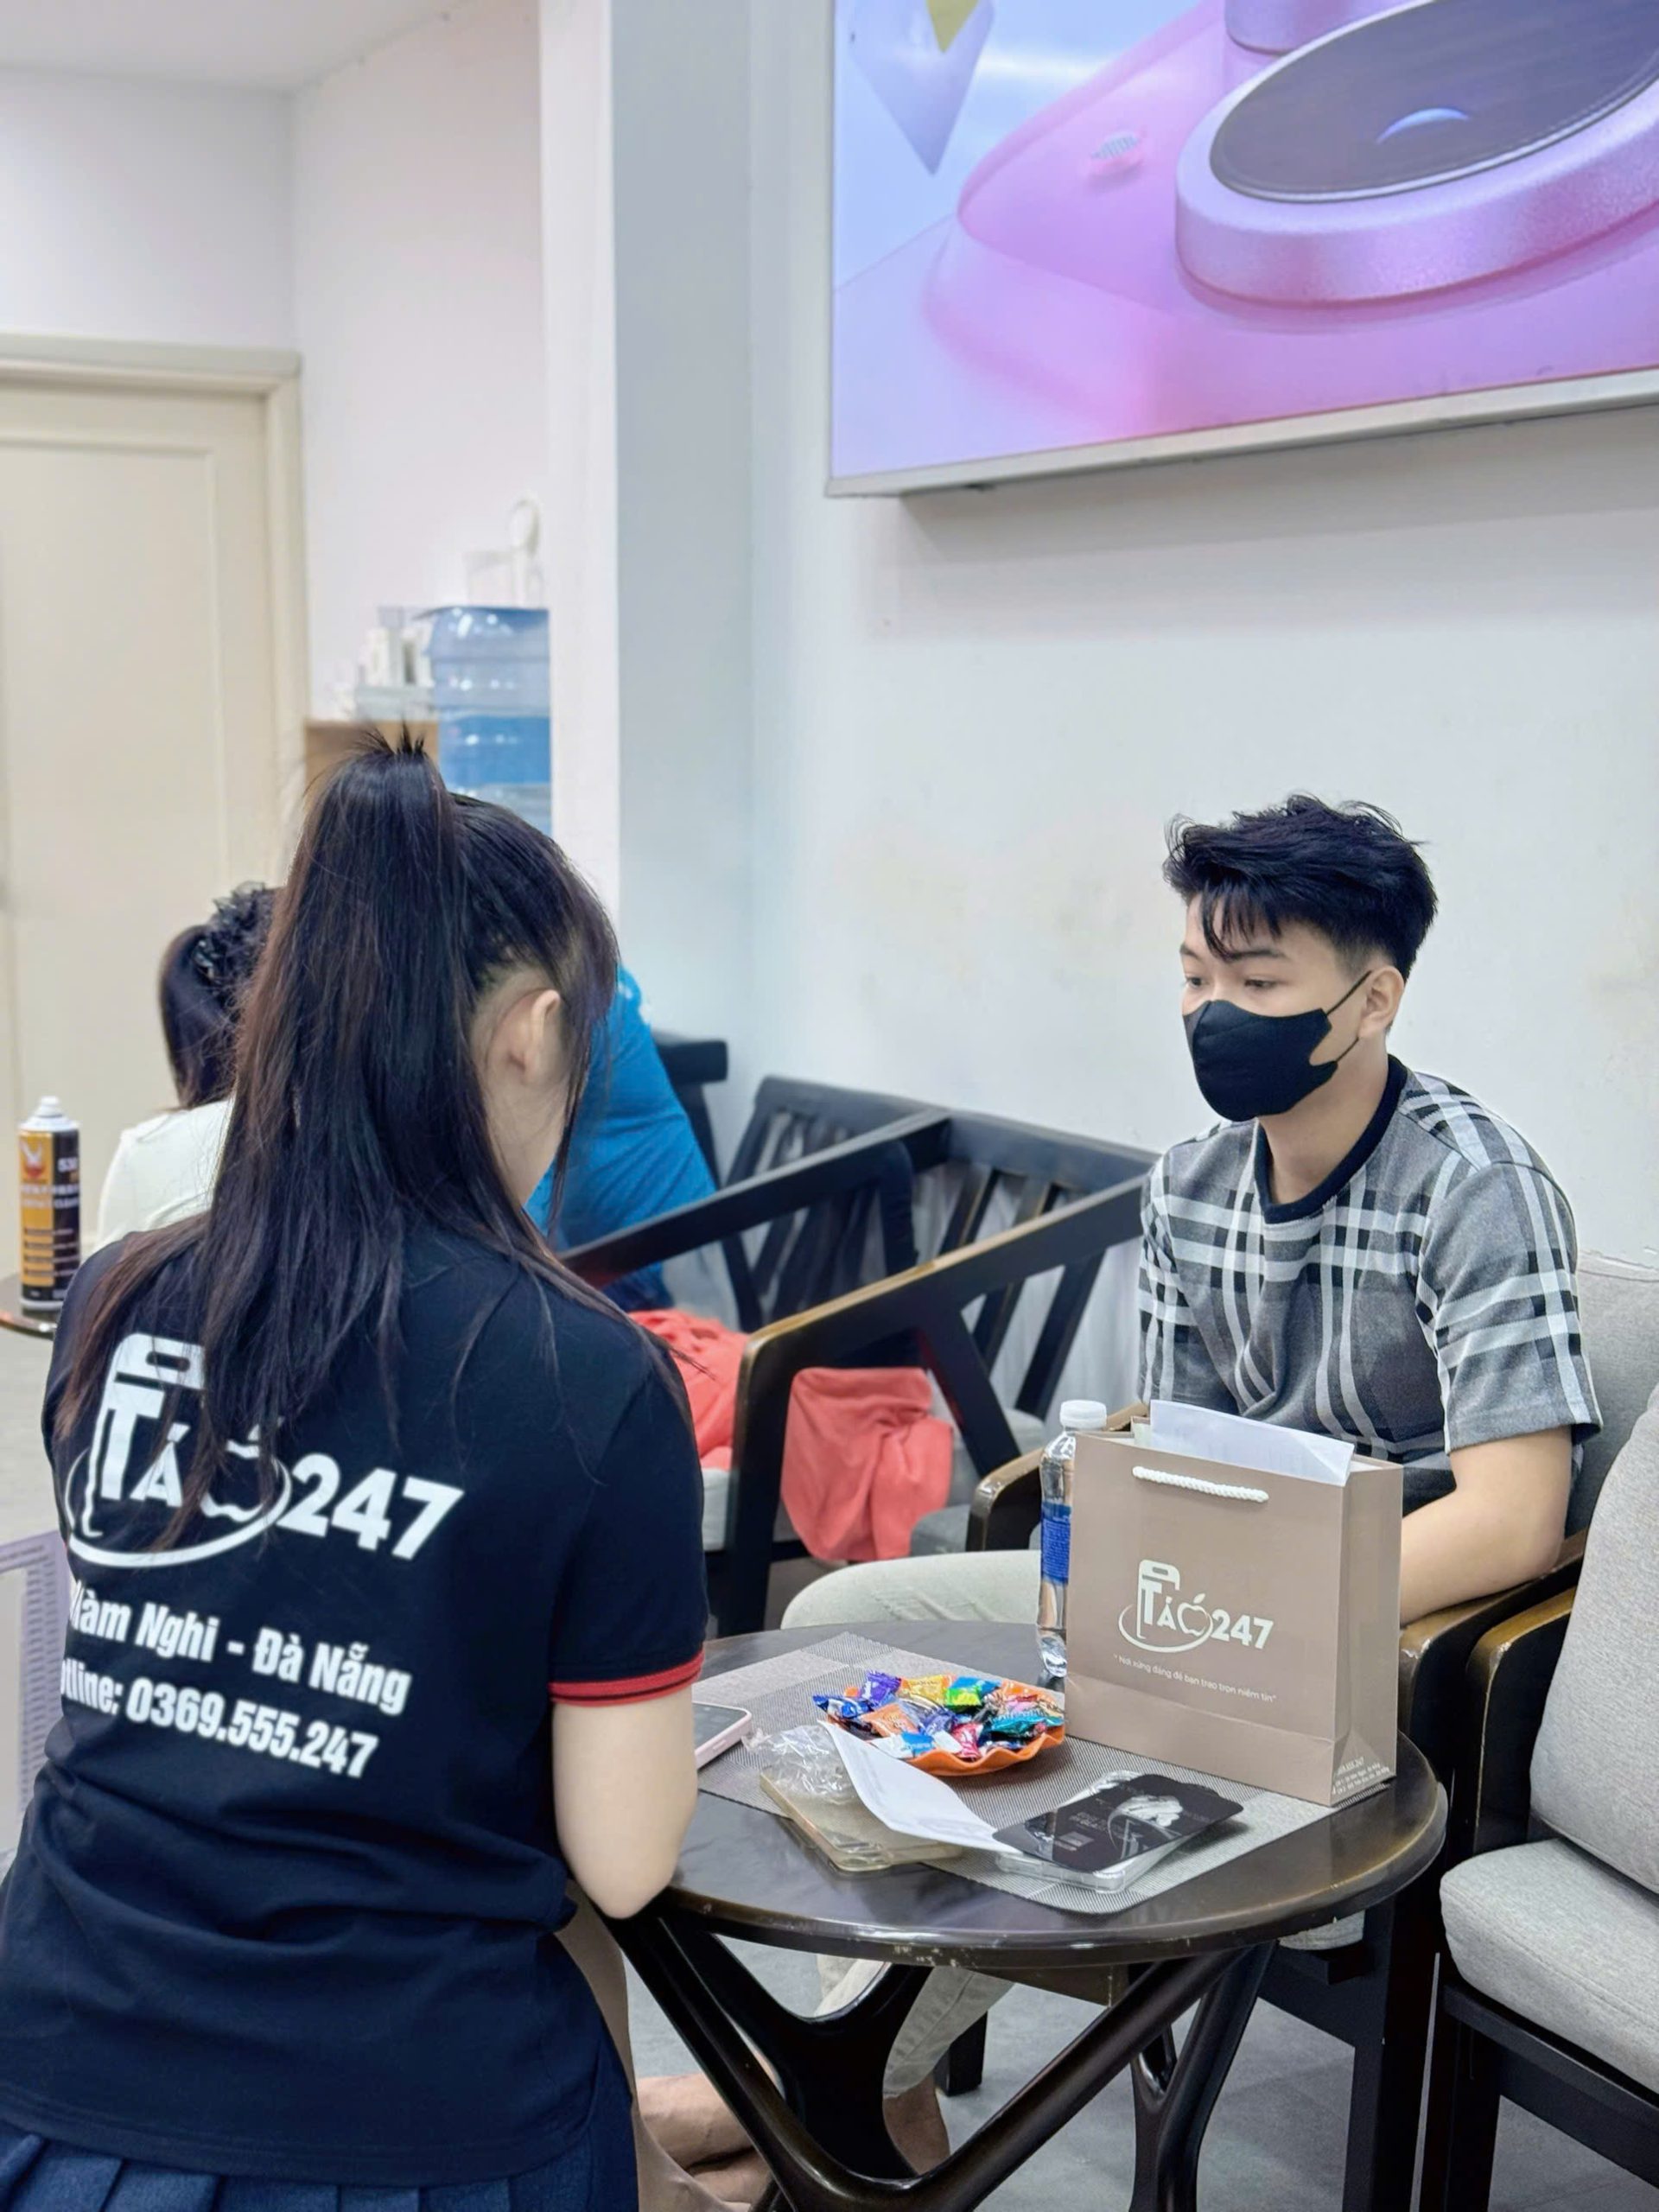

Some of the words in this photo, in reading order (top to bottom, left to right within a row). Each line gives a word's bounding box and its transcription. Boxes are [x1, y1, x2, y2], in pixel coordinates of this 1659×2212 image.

[135, 1601, 220, 1662] Nghi
[226, 1640, 245, 1656] -
[251, 1626, 304, 1683] Đà
[308, 1642, 413, 1717] Nẵng
[124, 1676, 379, 1779] 0369.555.247
